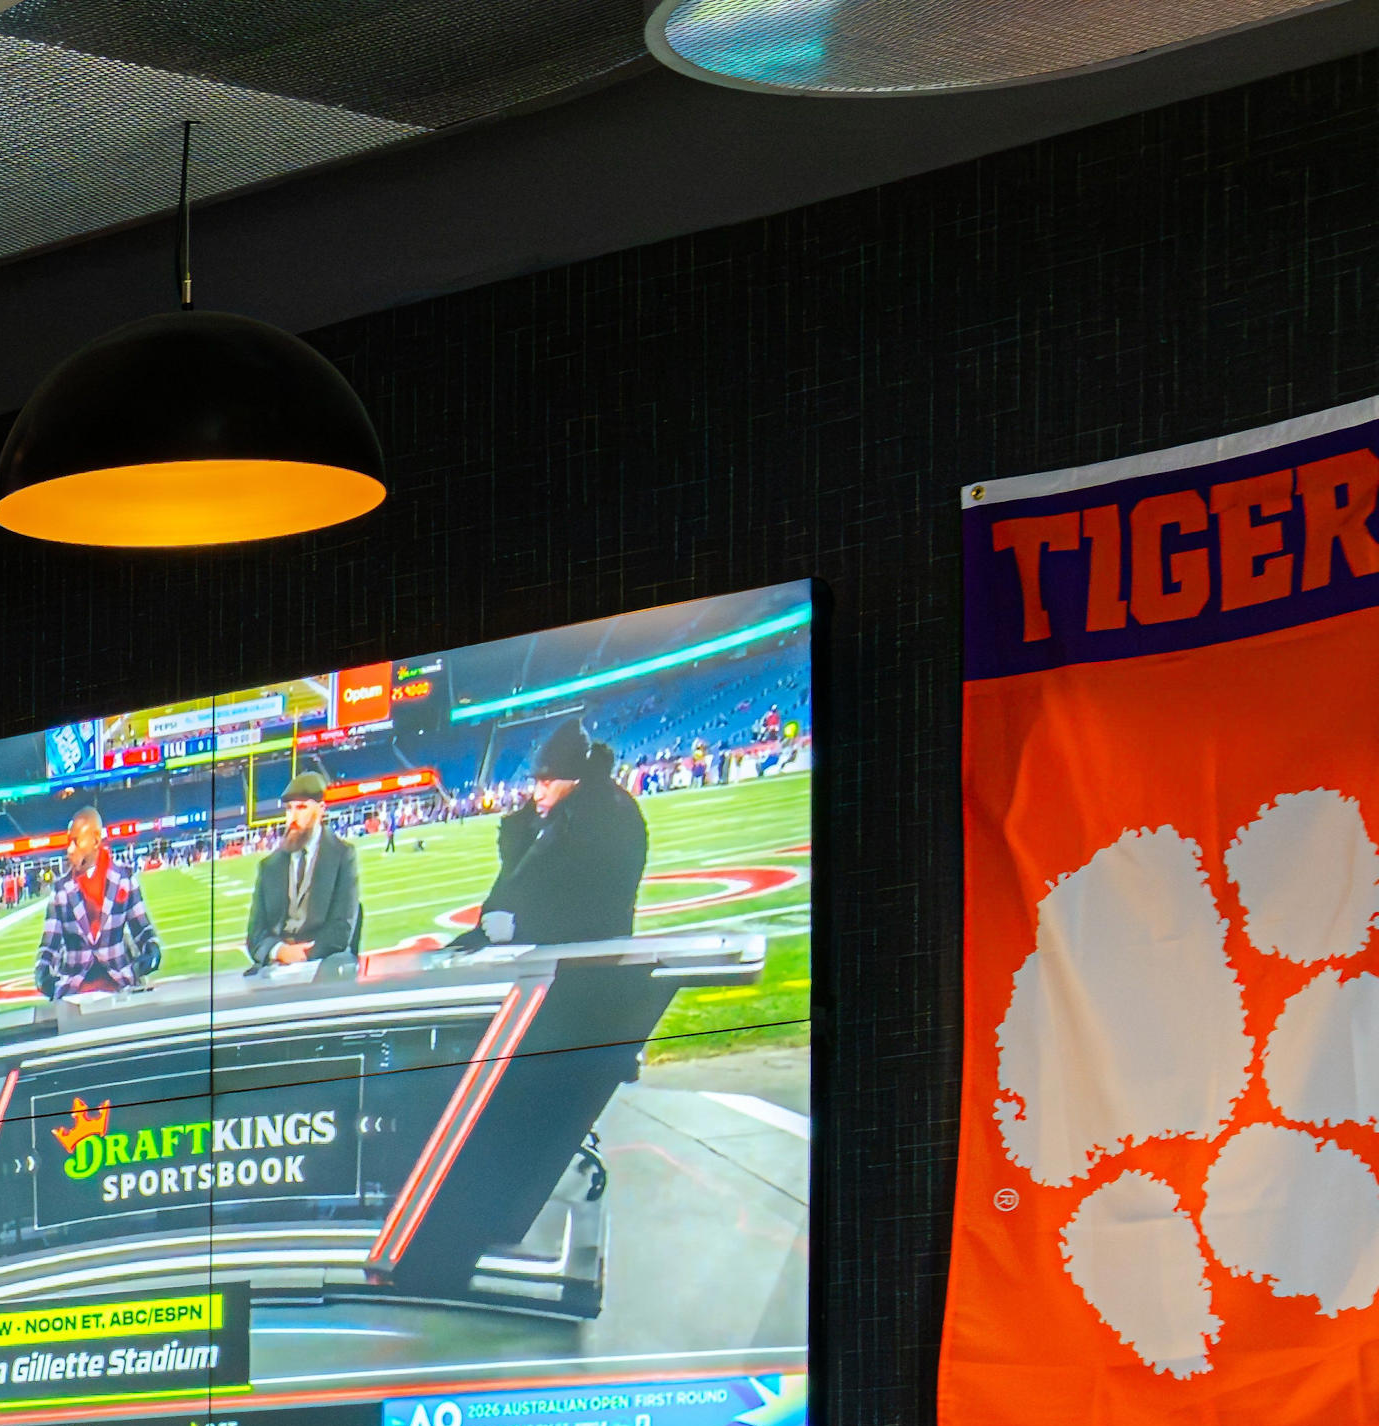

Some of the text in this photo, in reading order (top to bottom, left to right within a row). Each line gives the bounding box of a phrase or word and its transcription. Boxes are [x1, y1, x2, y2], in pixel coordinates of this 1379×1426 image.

[991, 447, 1379, 642] TIGER
[344, 685, 382, 704] Optum
[101, 1155, 305, 1202] SPORTSBOOK
[24, 1315, 78, 1335] NOON
[110, 1304, 203, 1328] ABC/ESPN
[11, 1348, 104, 1384] Gillette
[107, 1340, 219, 1377] Stadium
[467, 1404, 500, 1419] 2026
[503, 1398, 587, 1417] AUSTRALIAN
[590, 1395, 629, 1411] OPEN
[634, 1393, 672, 1408] FIRST
[677, 1389, 728, 1405] ROUND
